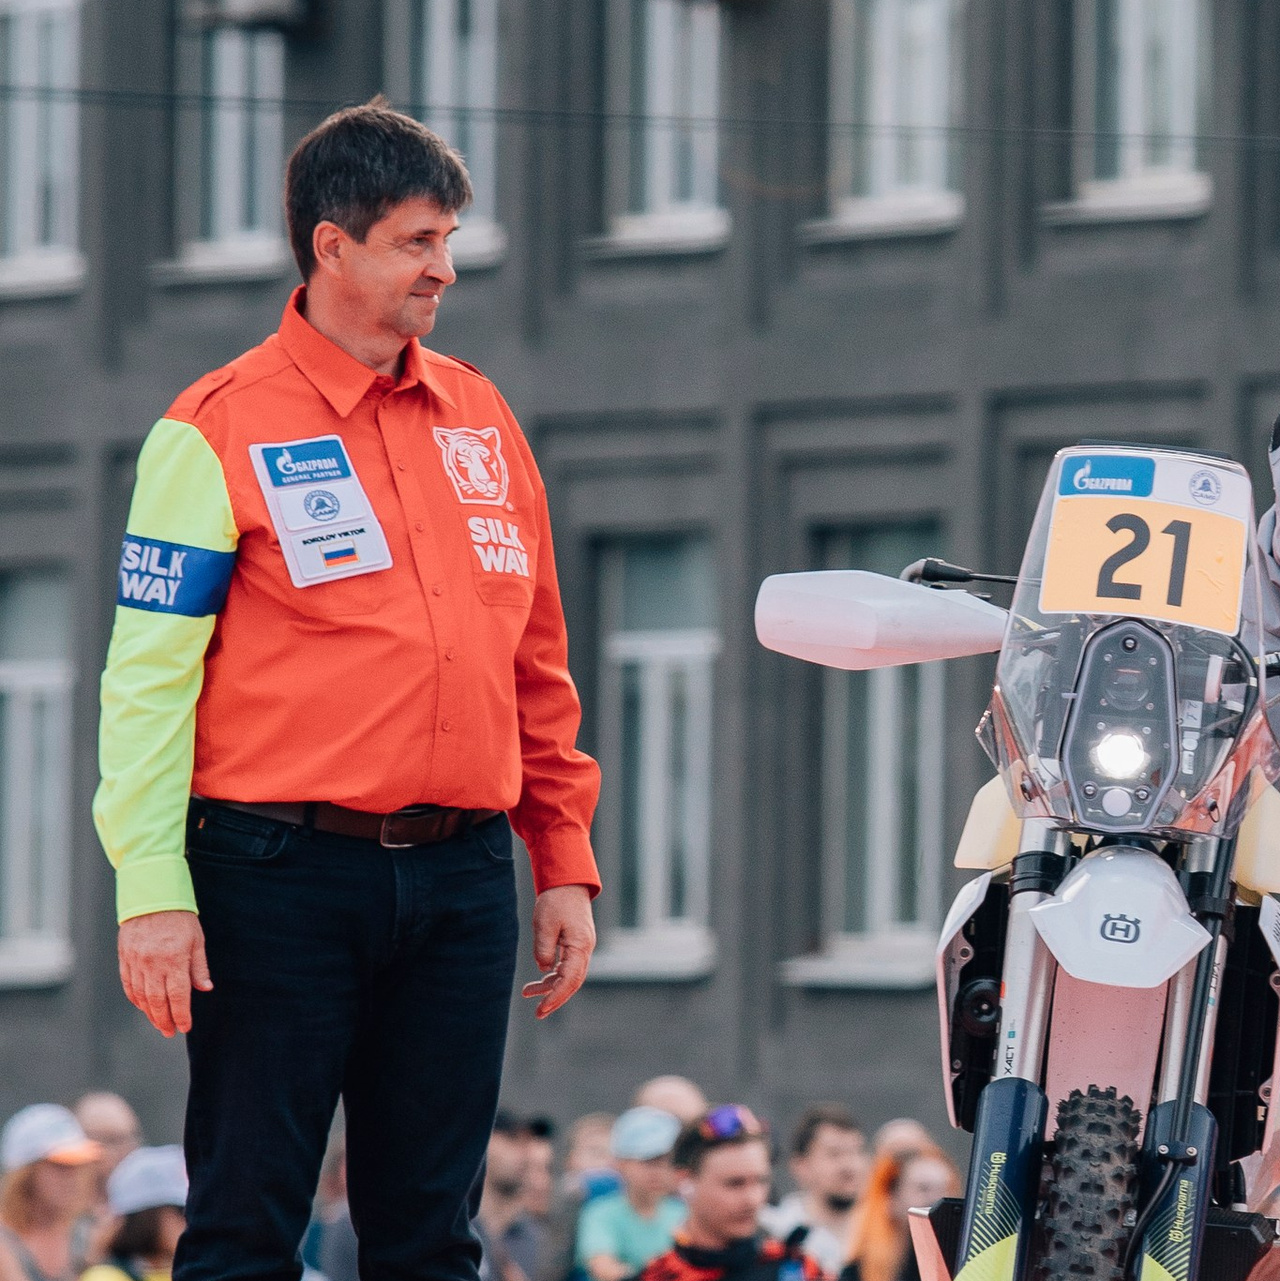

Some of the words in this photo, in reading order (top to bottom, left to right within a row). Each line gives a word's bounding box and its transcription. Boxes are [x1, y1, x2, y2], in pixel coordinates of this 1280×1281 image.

[295, 458, 339, 472] GAZPROM
[1086, 477, 1133, 491] GAZPROM
[467, 516, 526, 551] SILK
[122, 542, 187, 578] SILK
[473, 544, 530, 577] WAY
[1096, 513, 1192, 607] 21
[121, 571, 181, 606] WAY
[1004, 1044, 1016, 1075] XACT
[985, 1163, 1001, 1215] Husqvarna
[1173, 1179, 1189, 1230] Husqvarna
